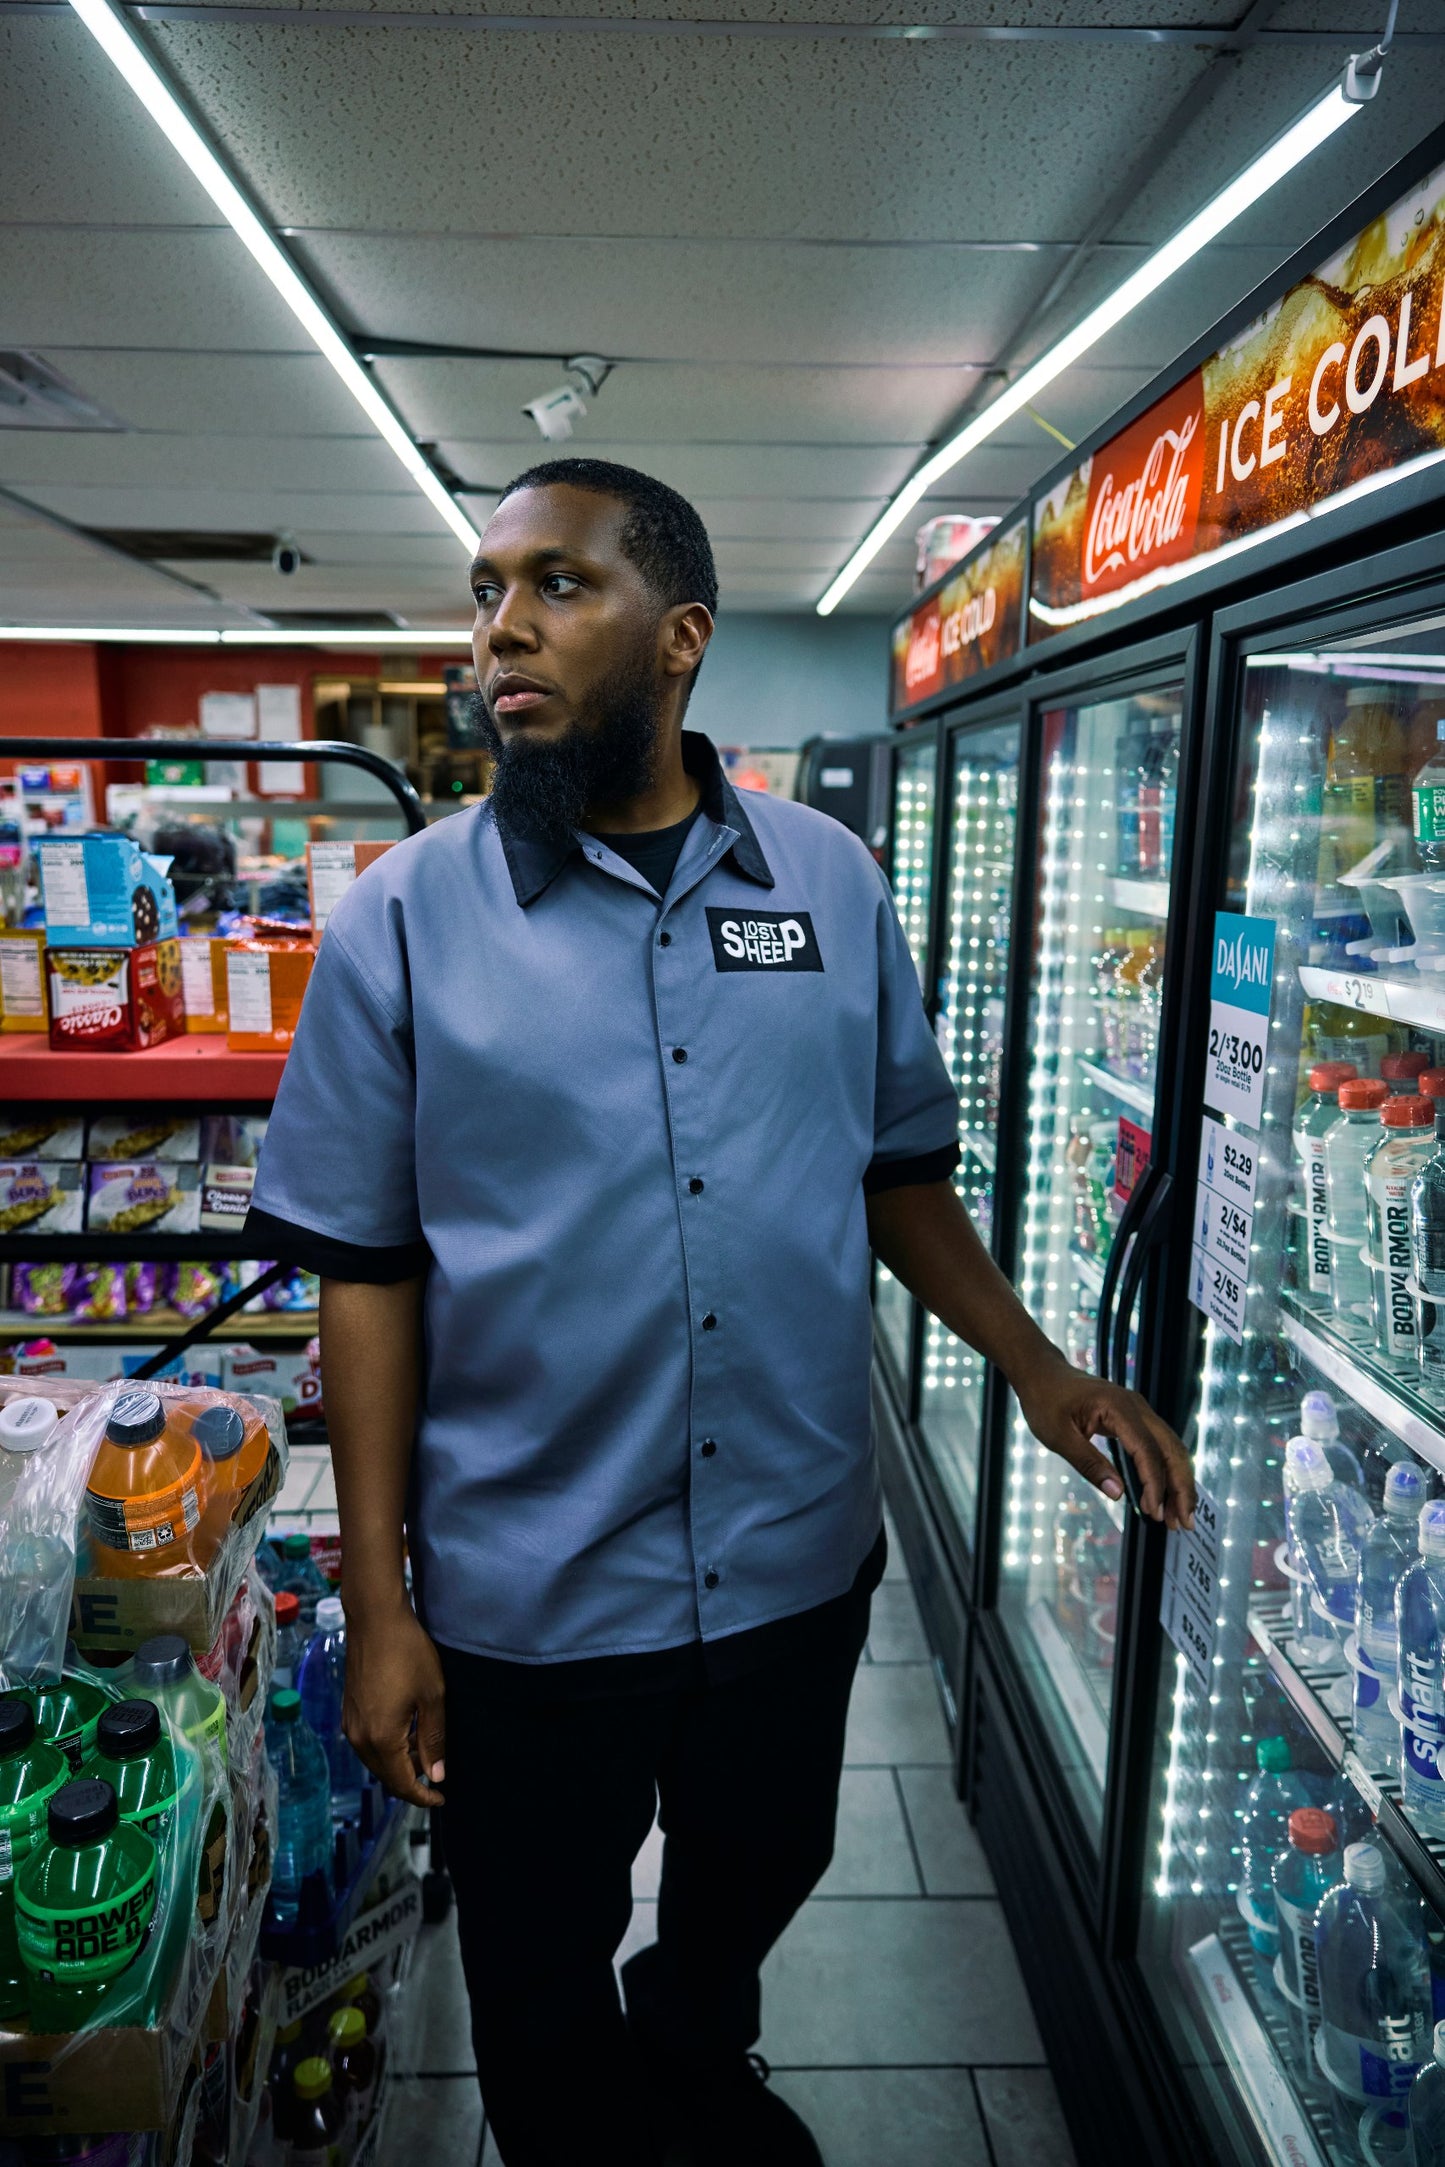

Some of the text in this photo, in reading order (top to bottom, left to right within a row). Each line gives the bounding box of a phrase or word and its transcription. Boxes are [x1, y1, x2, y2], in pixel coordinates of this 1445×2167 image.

[1216, 375, 1292, 494] ICE
[1085, 409, 1201, 584] Coca-Cola
[940, 611, 961, 659] ICE
[960, 587, 996, 645] COLD
[721, 919, 806, 964] SHEEP
[742, 921, 777, 940] LOST
[1216, 931, 1268, 991] DASANI
[61, 1005, 122, 1034] Classic
[1209, 1029, 1263, 1074] 2/$3.00
[1216, 1059, 1252, 1085] 20oz Bottle
[1223, 1144, 1252, 1177] $2.29
[206, 1189, 248, 1203] Cheese
[1220, 1205, 1247, 1239] 2/$4
[1213, 1270, 1239, 1303] 2/$5
[1195, 1499, 1216, 1531] /$4
[54, 1877, 154, 1937] POWER
[56, 1929, 120, 1961] ADE
[1378, 2013, 1414, 2098] mart
